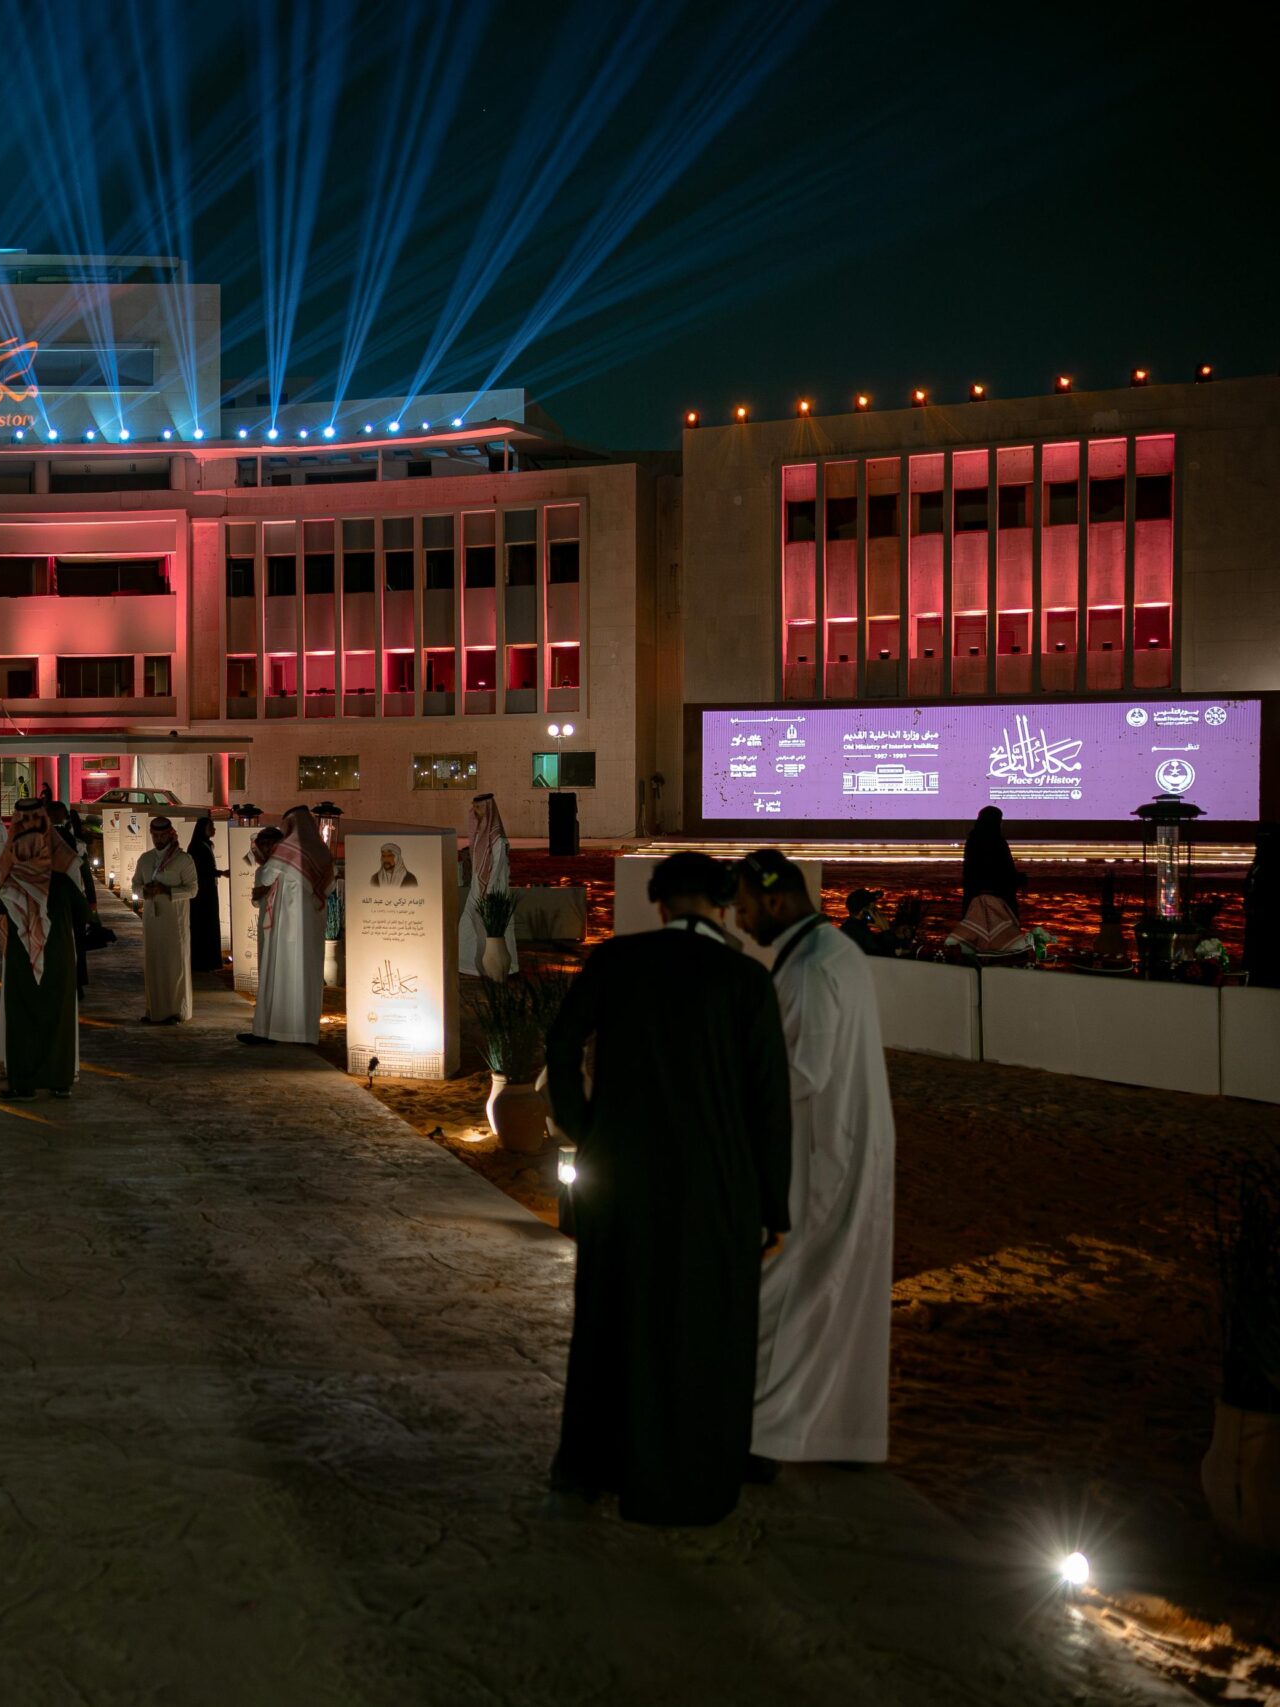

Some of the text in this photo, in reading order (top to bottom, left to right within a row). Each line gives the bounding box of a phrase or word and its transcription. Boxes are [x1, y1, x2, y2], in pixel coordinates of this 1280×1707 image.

[843, 730, 939, 742] مبنى وزارة الداخلية القديم
[914, 742, 939, 750] building
[1023, 728, 1083, 778] مكان
[1007, 774, 1082, 787] Place of History
[362, 897, 425, 909] الإمام تركي بن عبد الله
